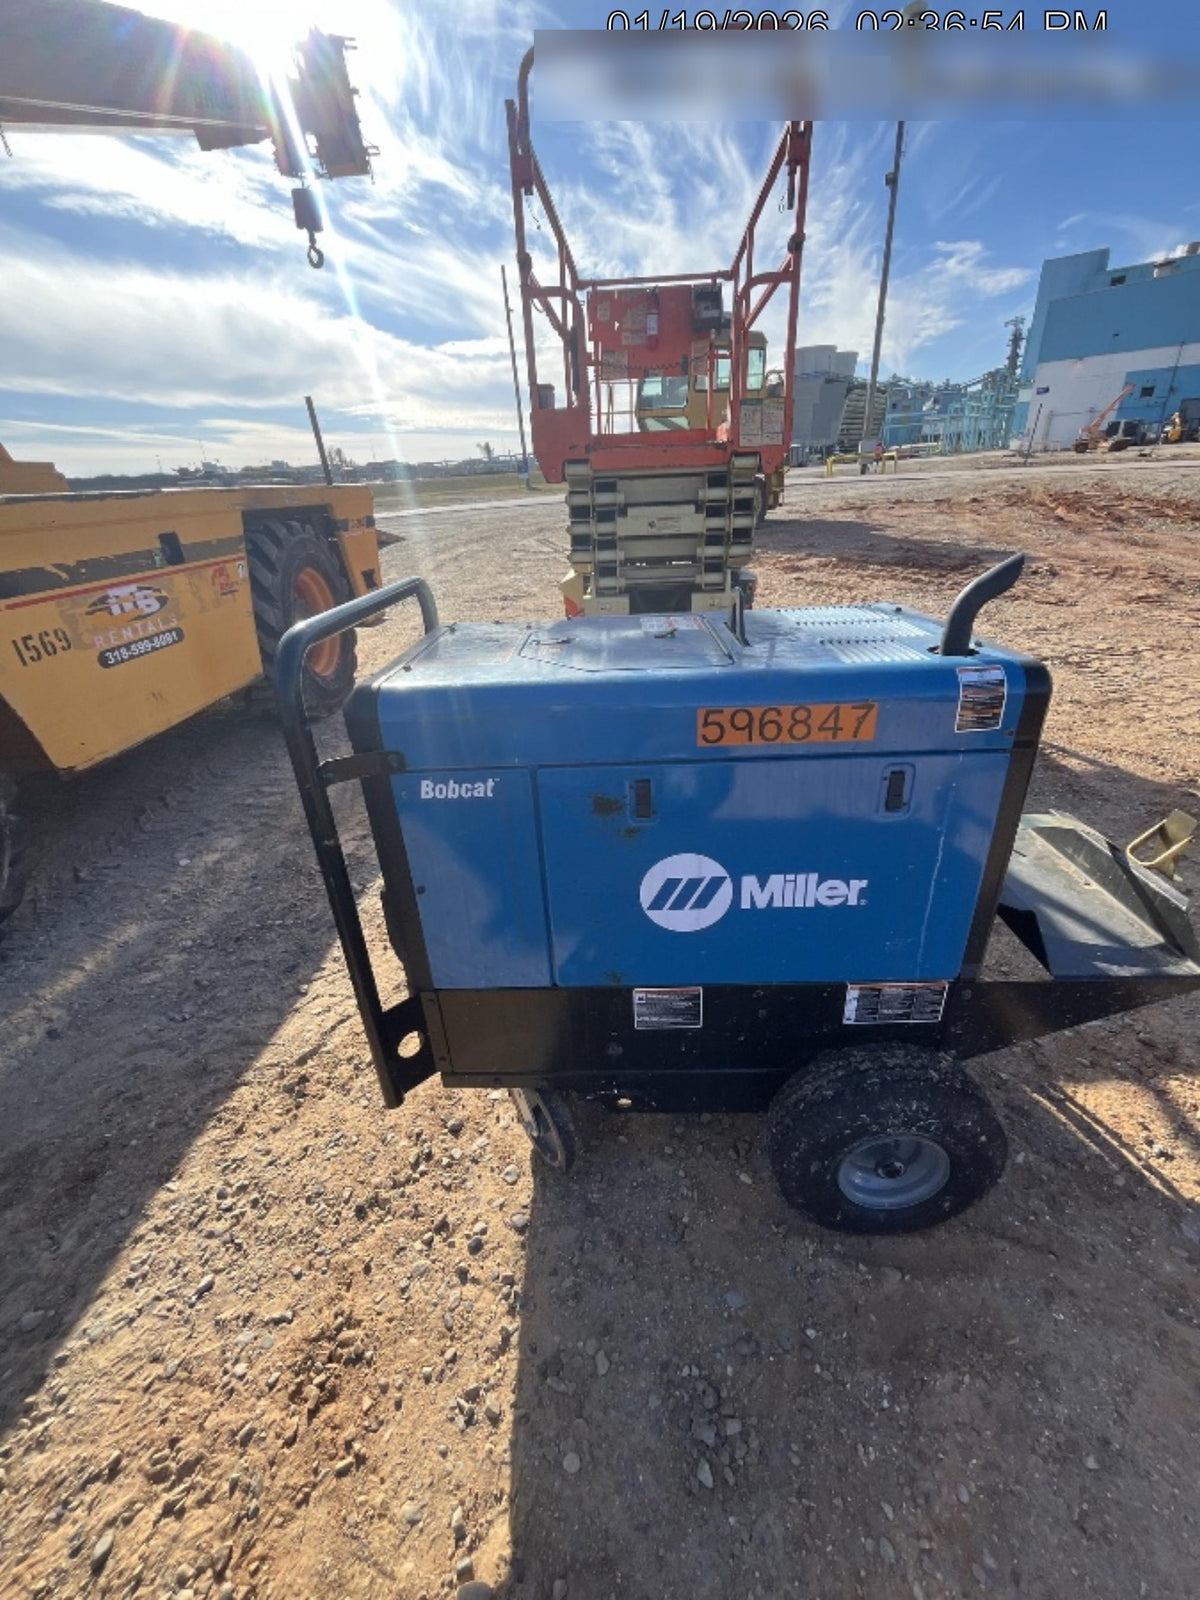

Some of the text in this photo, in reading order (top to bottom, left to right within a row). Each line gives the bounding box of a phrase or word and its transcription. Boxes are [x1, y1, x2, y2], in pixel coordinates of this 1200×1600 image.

[11, 627, 72, 668] 1569
[93, 617, 179, 649] RENTALS
[701, 698, 876, 744] 596847
[420, 778, 495, 799] Bobcat
[741, 872, 868, 909] Miller
